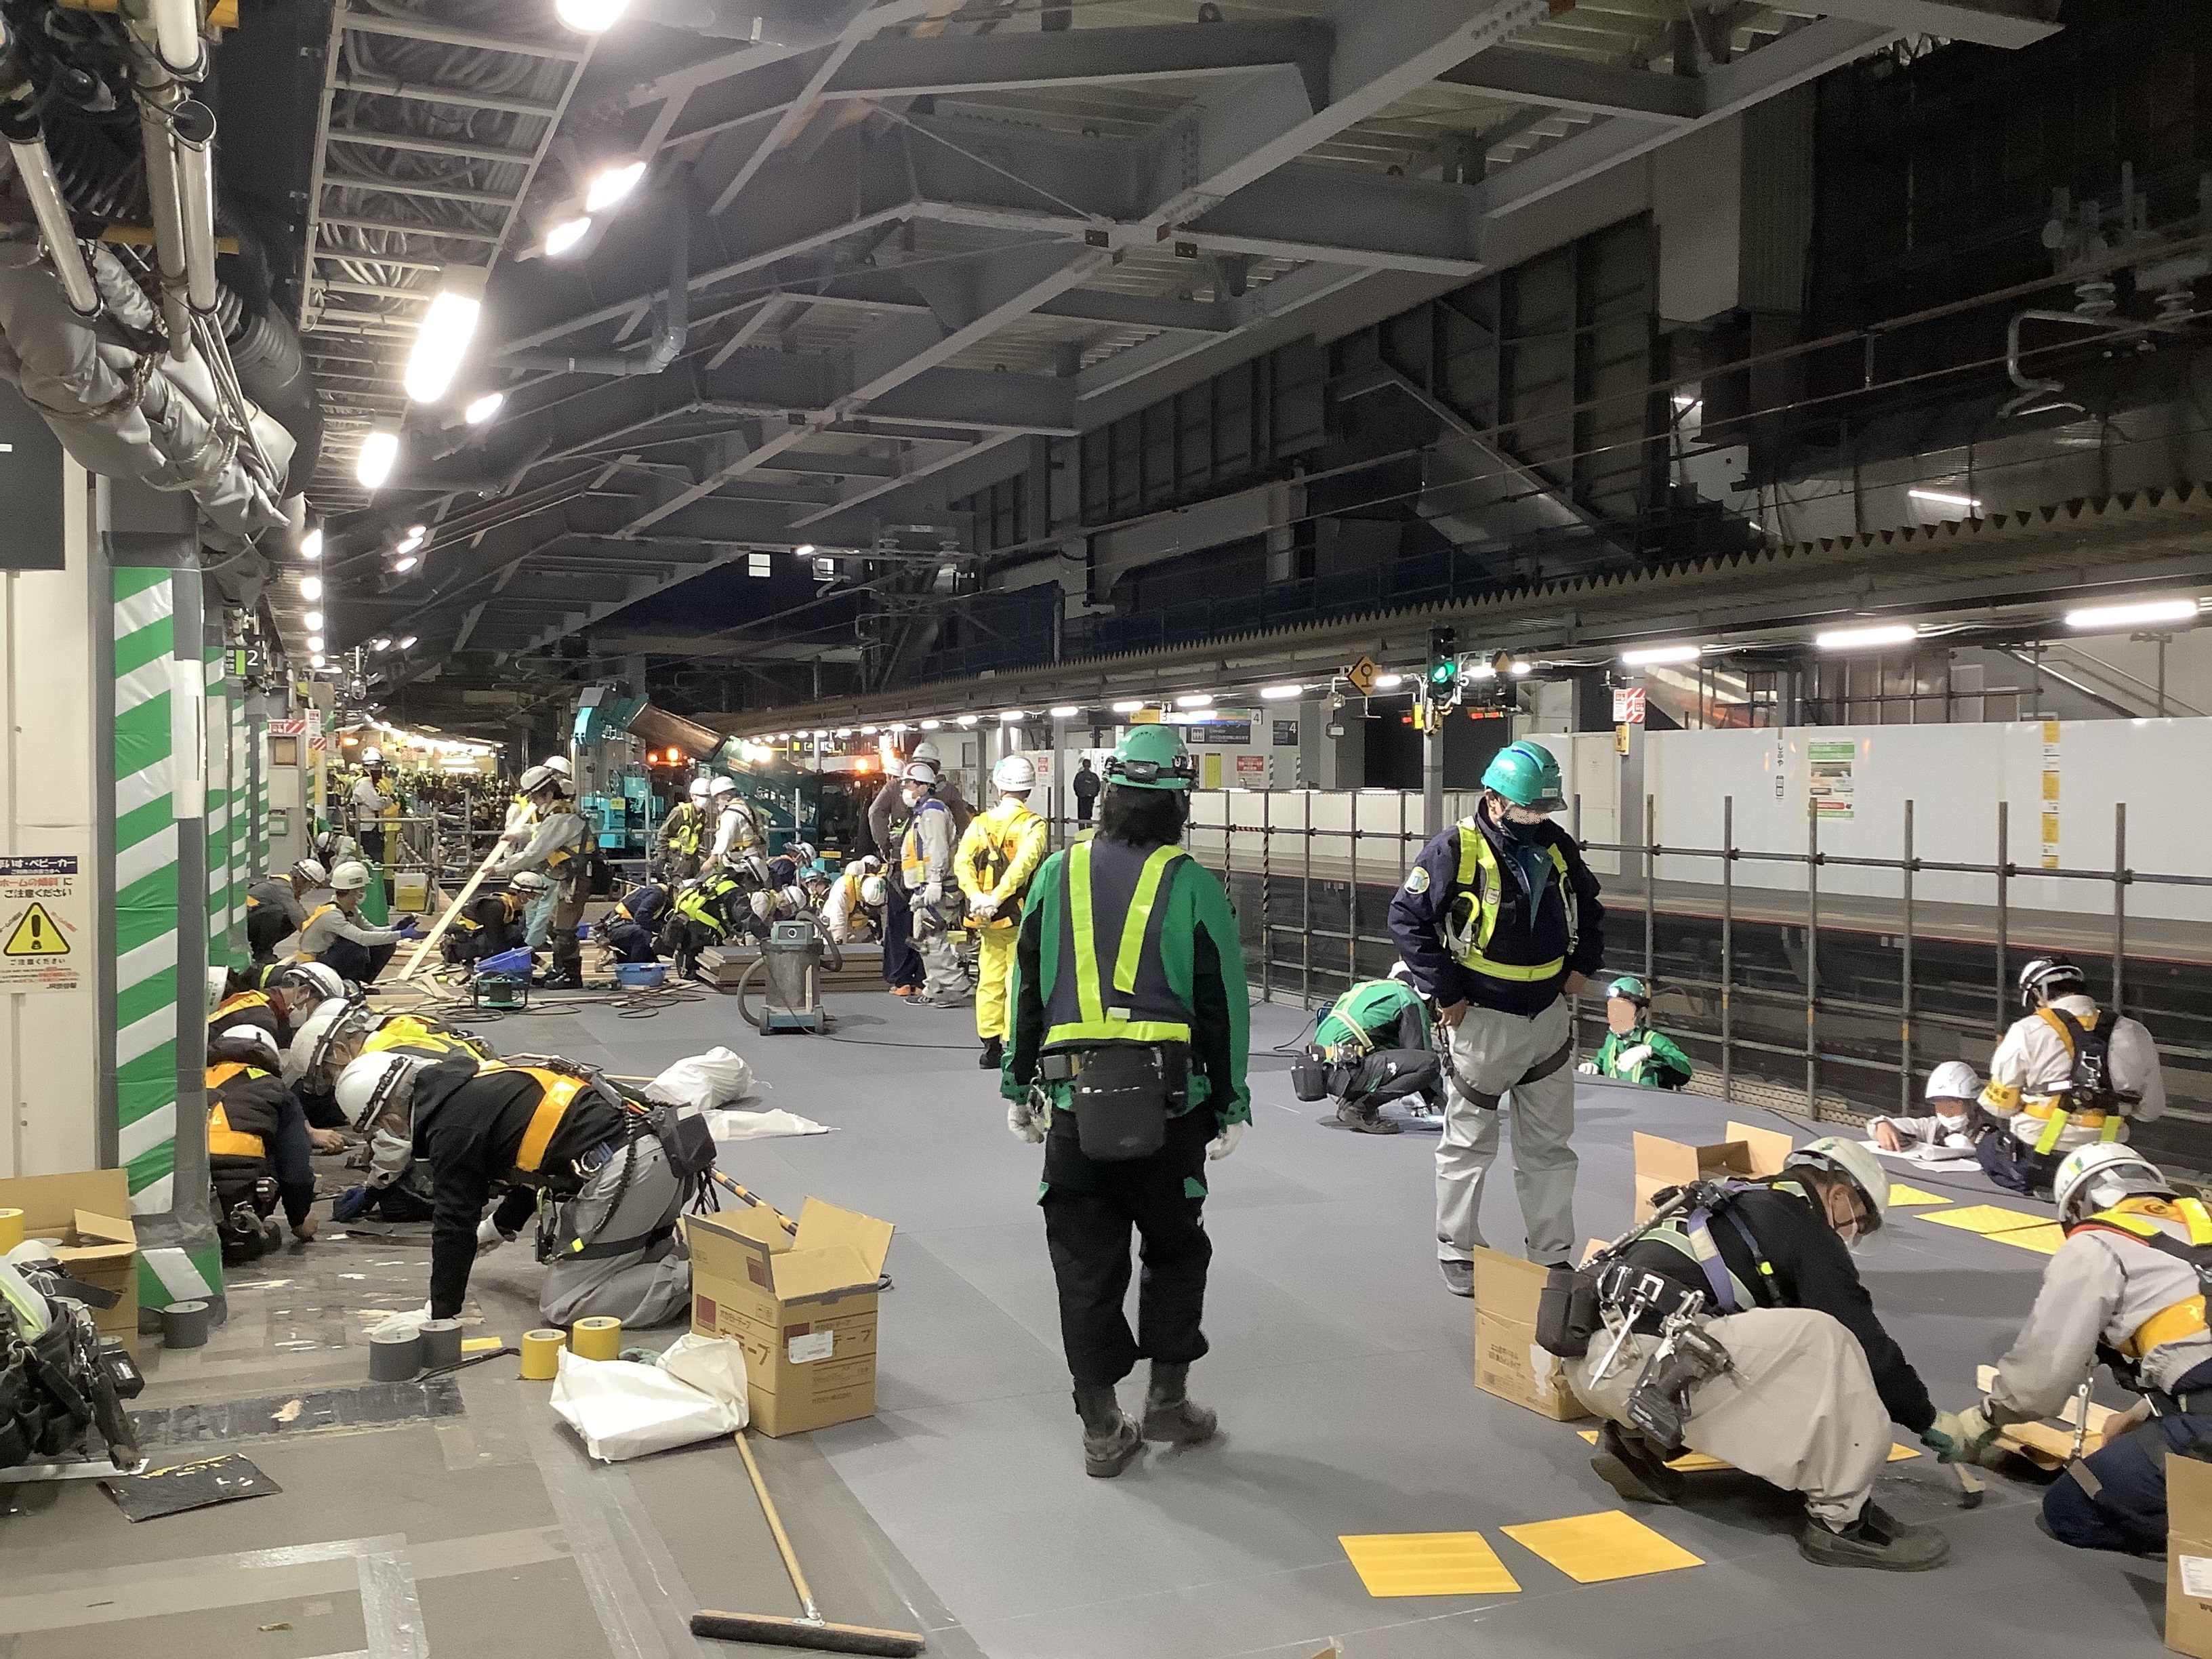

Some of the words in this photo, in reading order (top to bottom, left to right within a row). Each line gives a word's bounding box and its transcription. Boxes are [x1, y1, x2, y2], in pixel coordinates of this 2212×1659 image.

[247, 650, 258, 666] 2
[1459, 669, 1470, 687] 5
[1162, 714, 1168, 722] 3
[1253, 713, 1260, 723] 4
[1289, 722, 1297, 734] 4
[5, 888, 72, 898] ご注意ください
